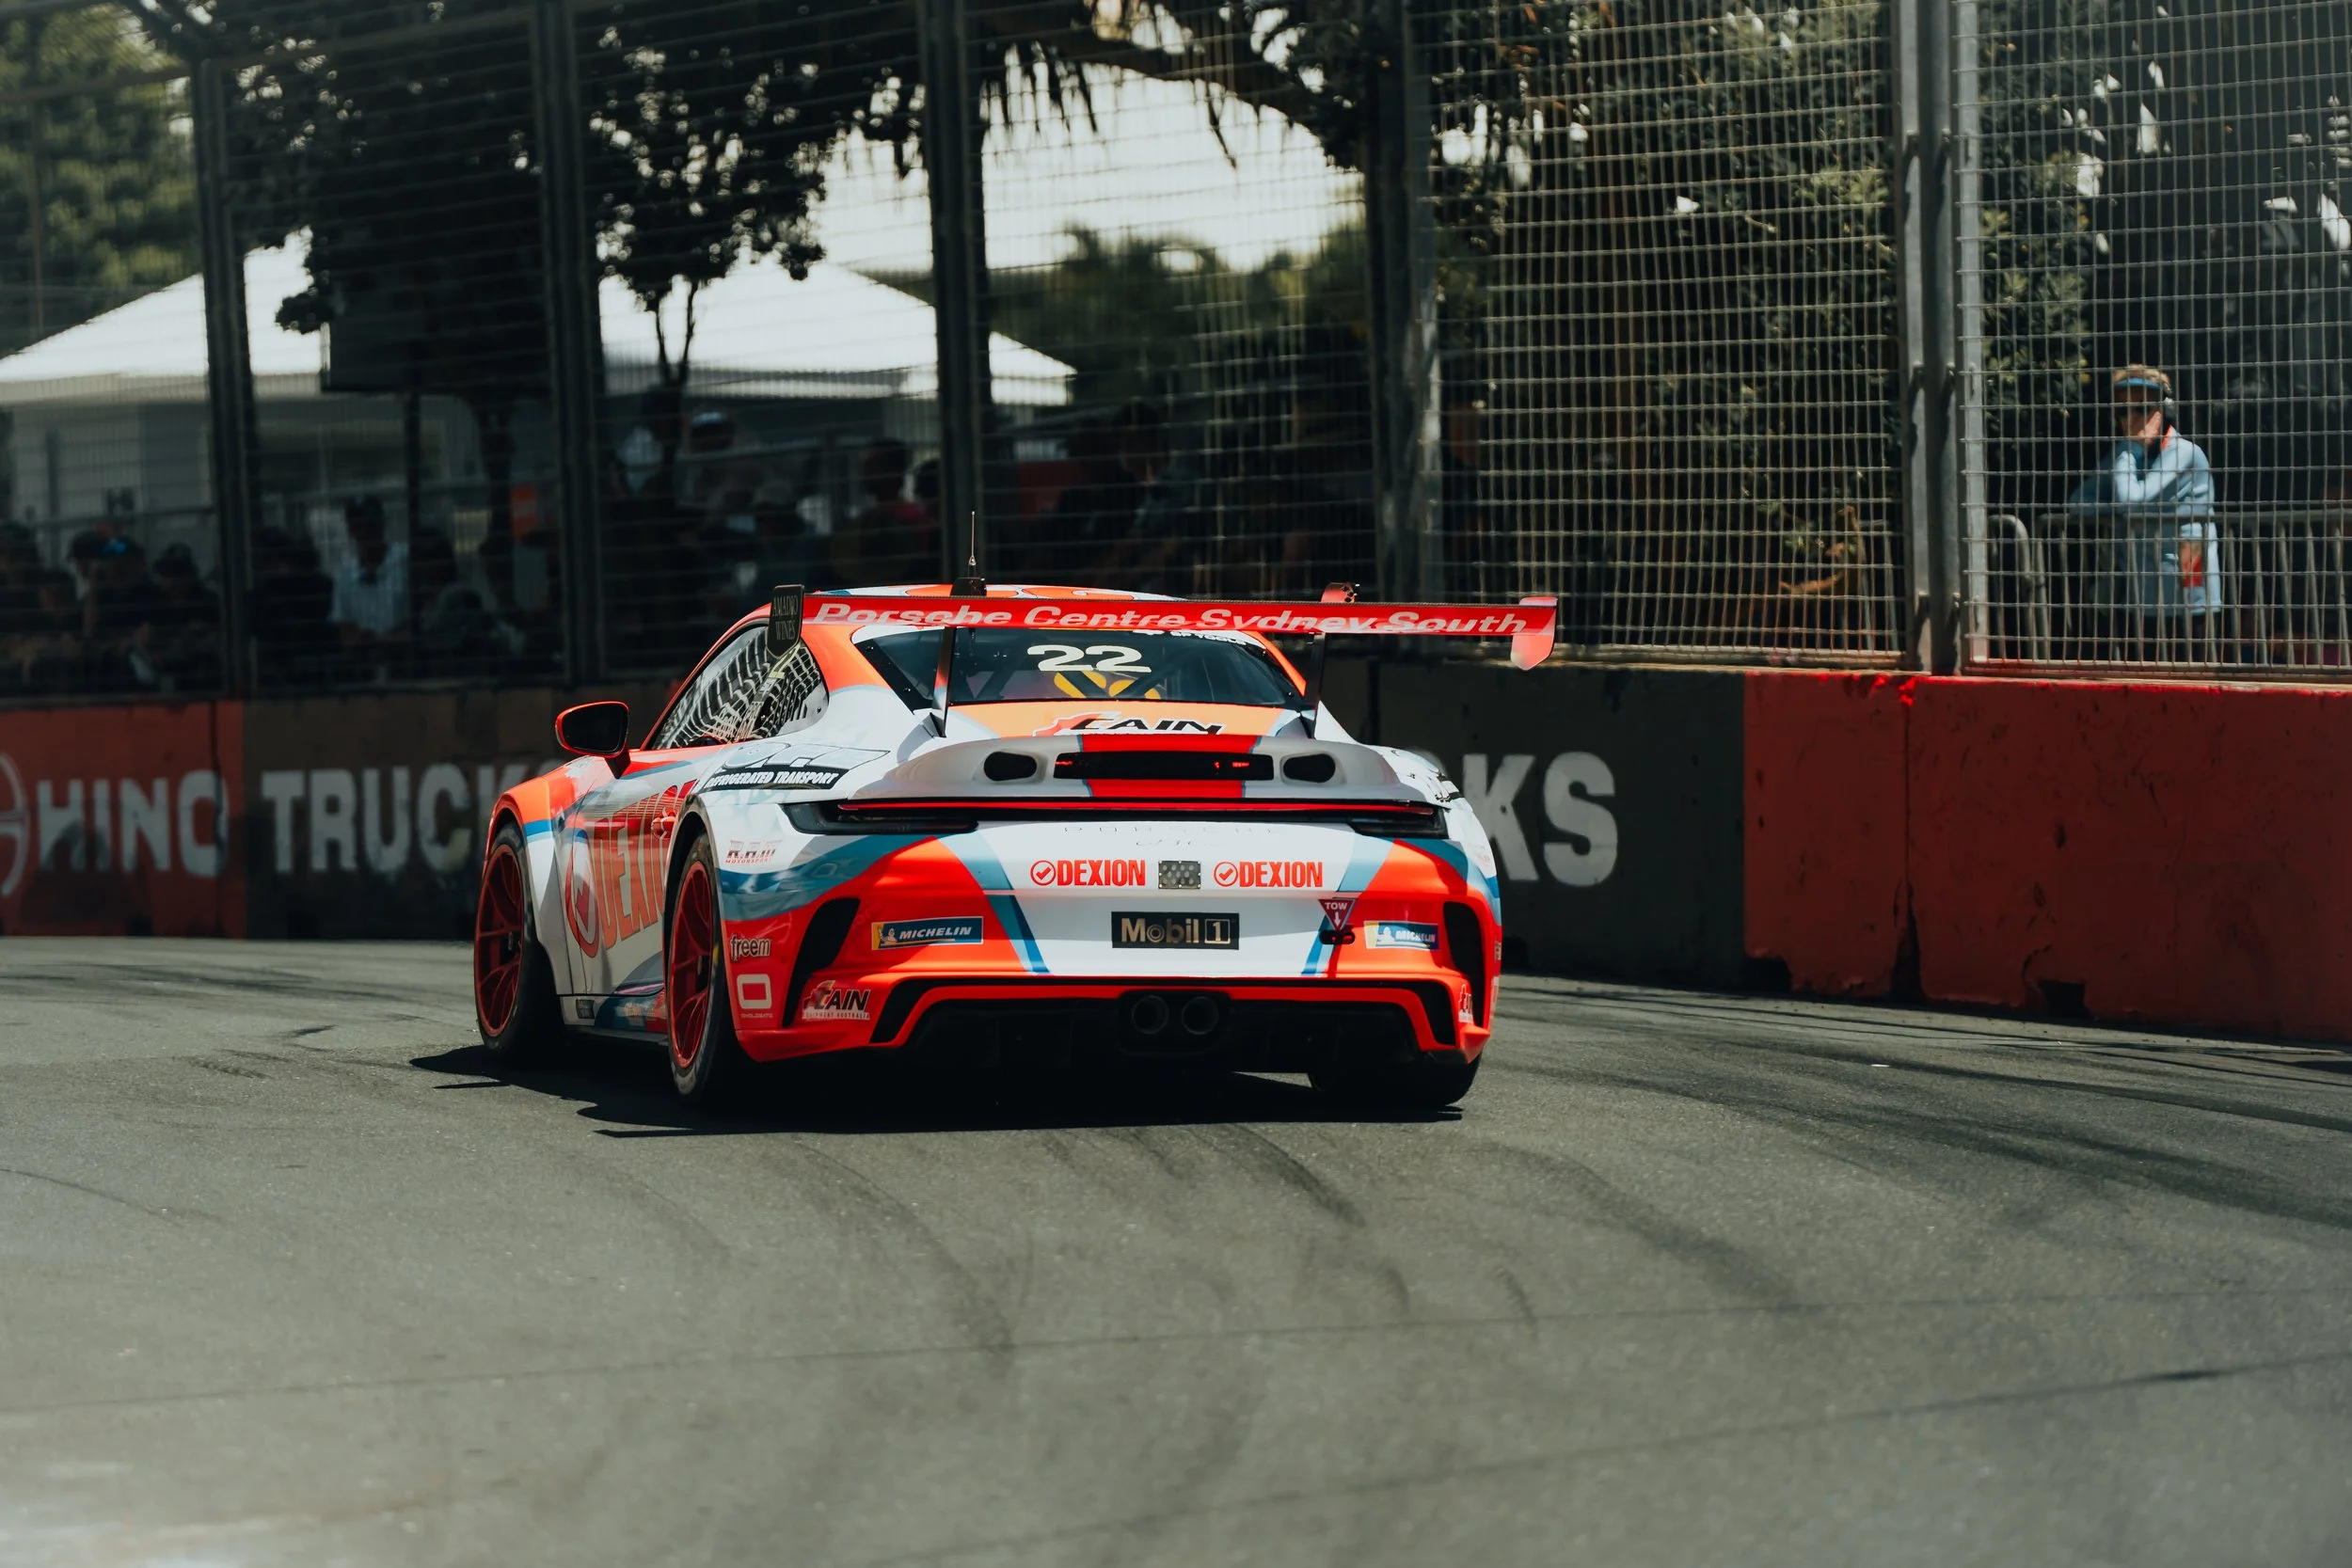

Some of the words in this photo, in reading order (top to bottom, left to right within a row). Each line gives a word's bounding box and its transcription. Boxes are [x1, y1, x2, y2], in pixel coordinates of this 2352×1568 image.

[813, 602, 1012, 626] Porsche
[1023, 605, 1185, 627] Centre
[1199, 609, 1377, 632] Sydney
[1379, 611, 1527, 633] South
[1026, 644, 1152, 673] 22
[772, 770, 839, 784] TRANSPORT
[38, 768, 230, 879] HINO
[1057, 859, 1146, 887] DEXION
[1239, 861, 1323, 888] DEXION
[1324, 901, 1348, 911] TOW
[898, 927, 972, 940] MICHELIN
[1120, 917, 1200, 944] Mobil
[1394, 929, 1437, 943] MICHELIN
[729, 933, 772, 961] freem
